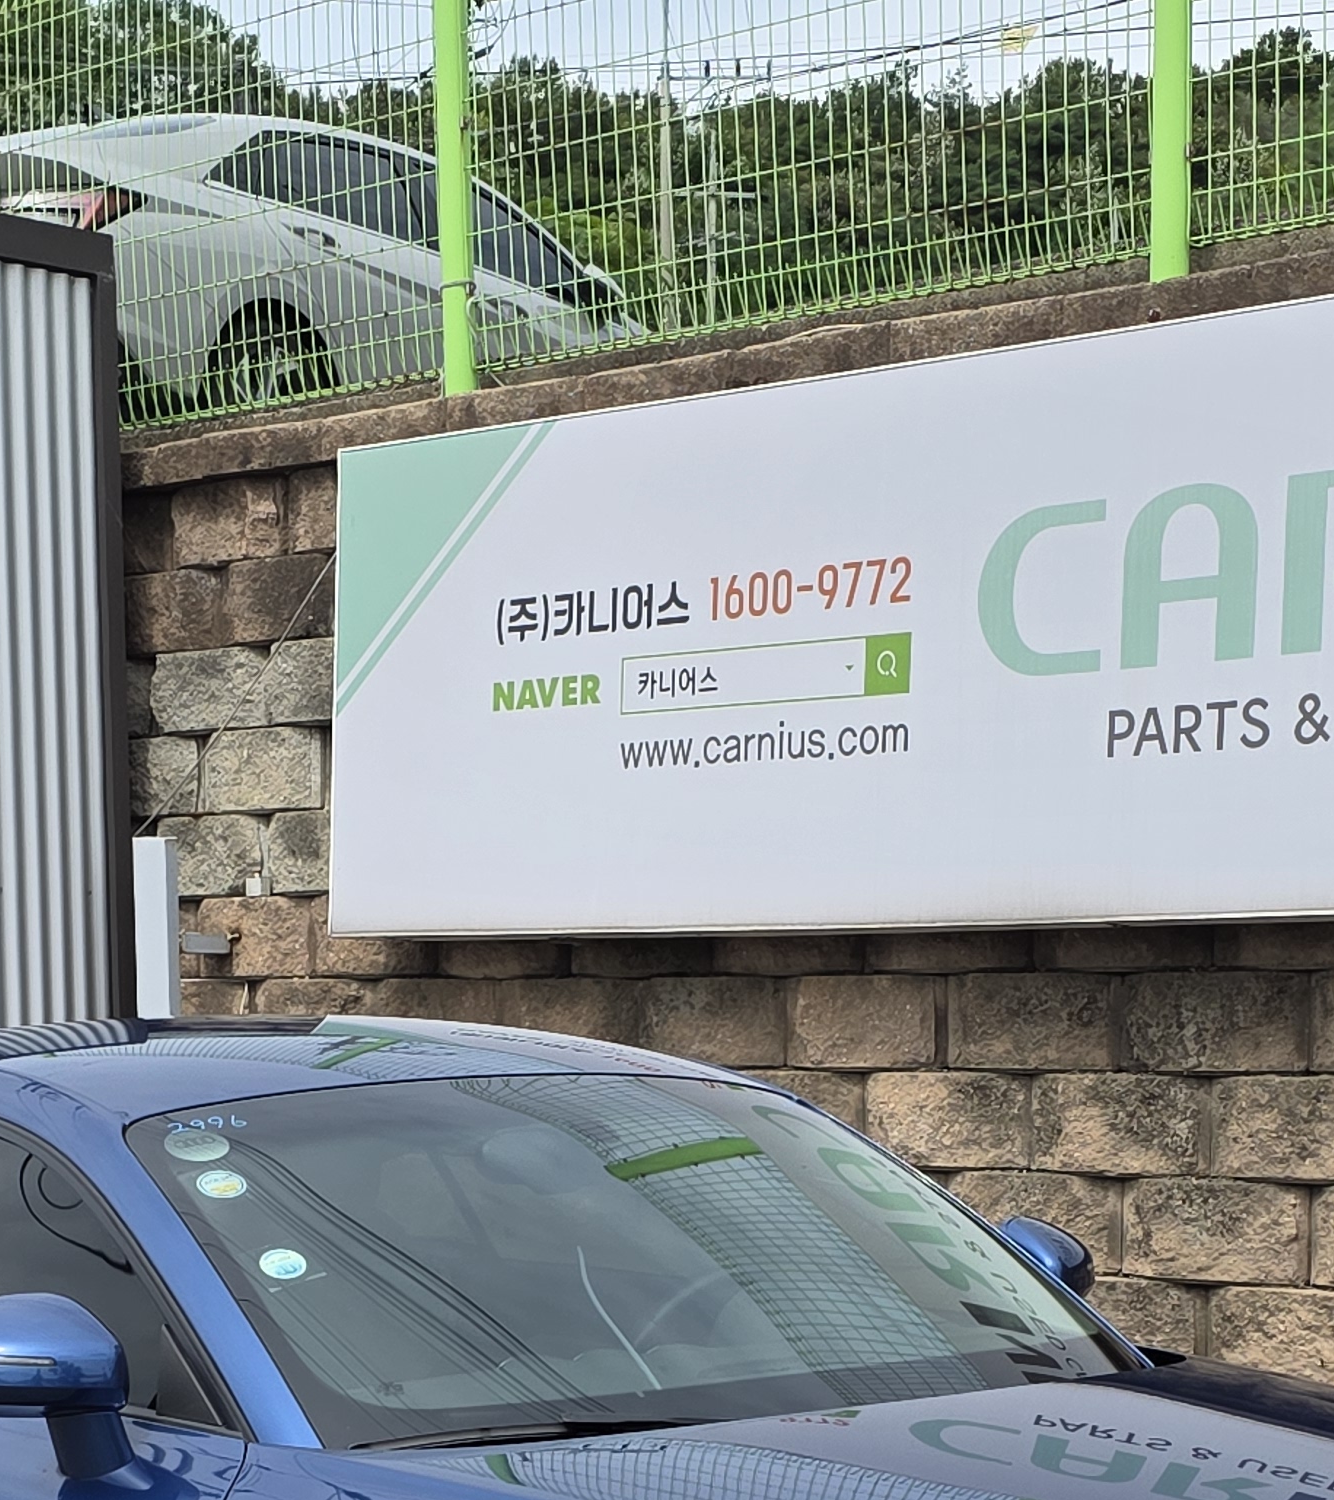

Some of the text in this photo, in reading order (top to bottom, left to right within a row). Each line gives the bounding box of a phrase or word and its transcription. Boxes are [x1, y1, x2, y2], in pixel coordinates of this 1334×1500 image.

[496, 556, 913, 645] (주)카니어스 1600-9772
[492, 663, 719, 712] NAVER 카니어스
[620, 720, 910, 770] www.carnius.com
[1106, 697, 1270, 760] PARTS
[1293, 692, 1333, 745] &
